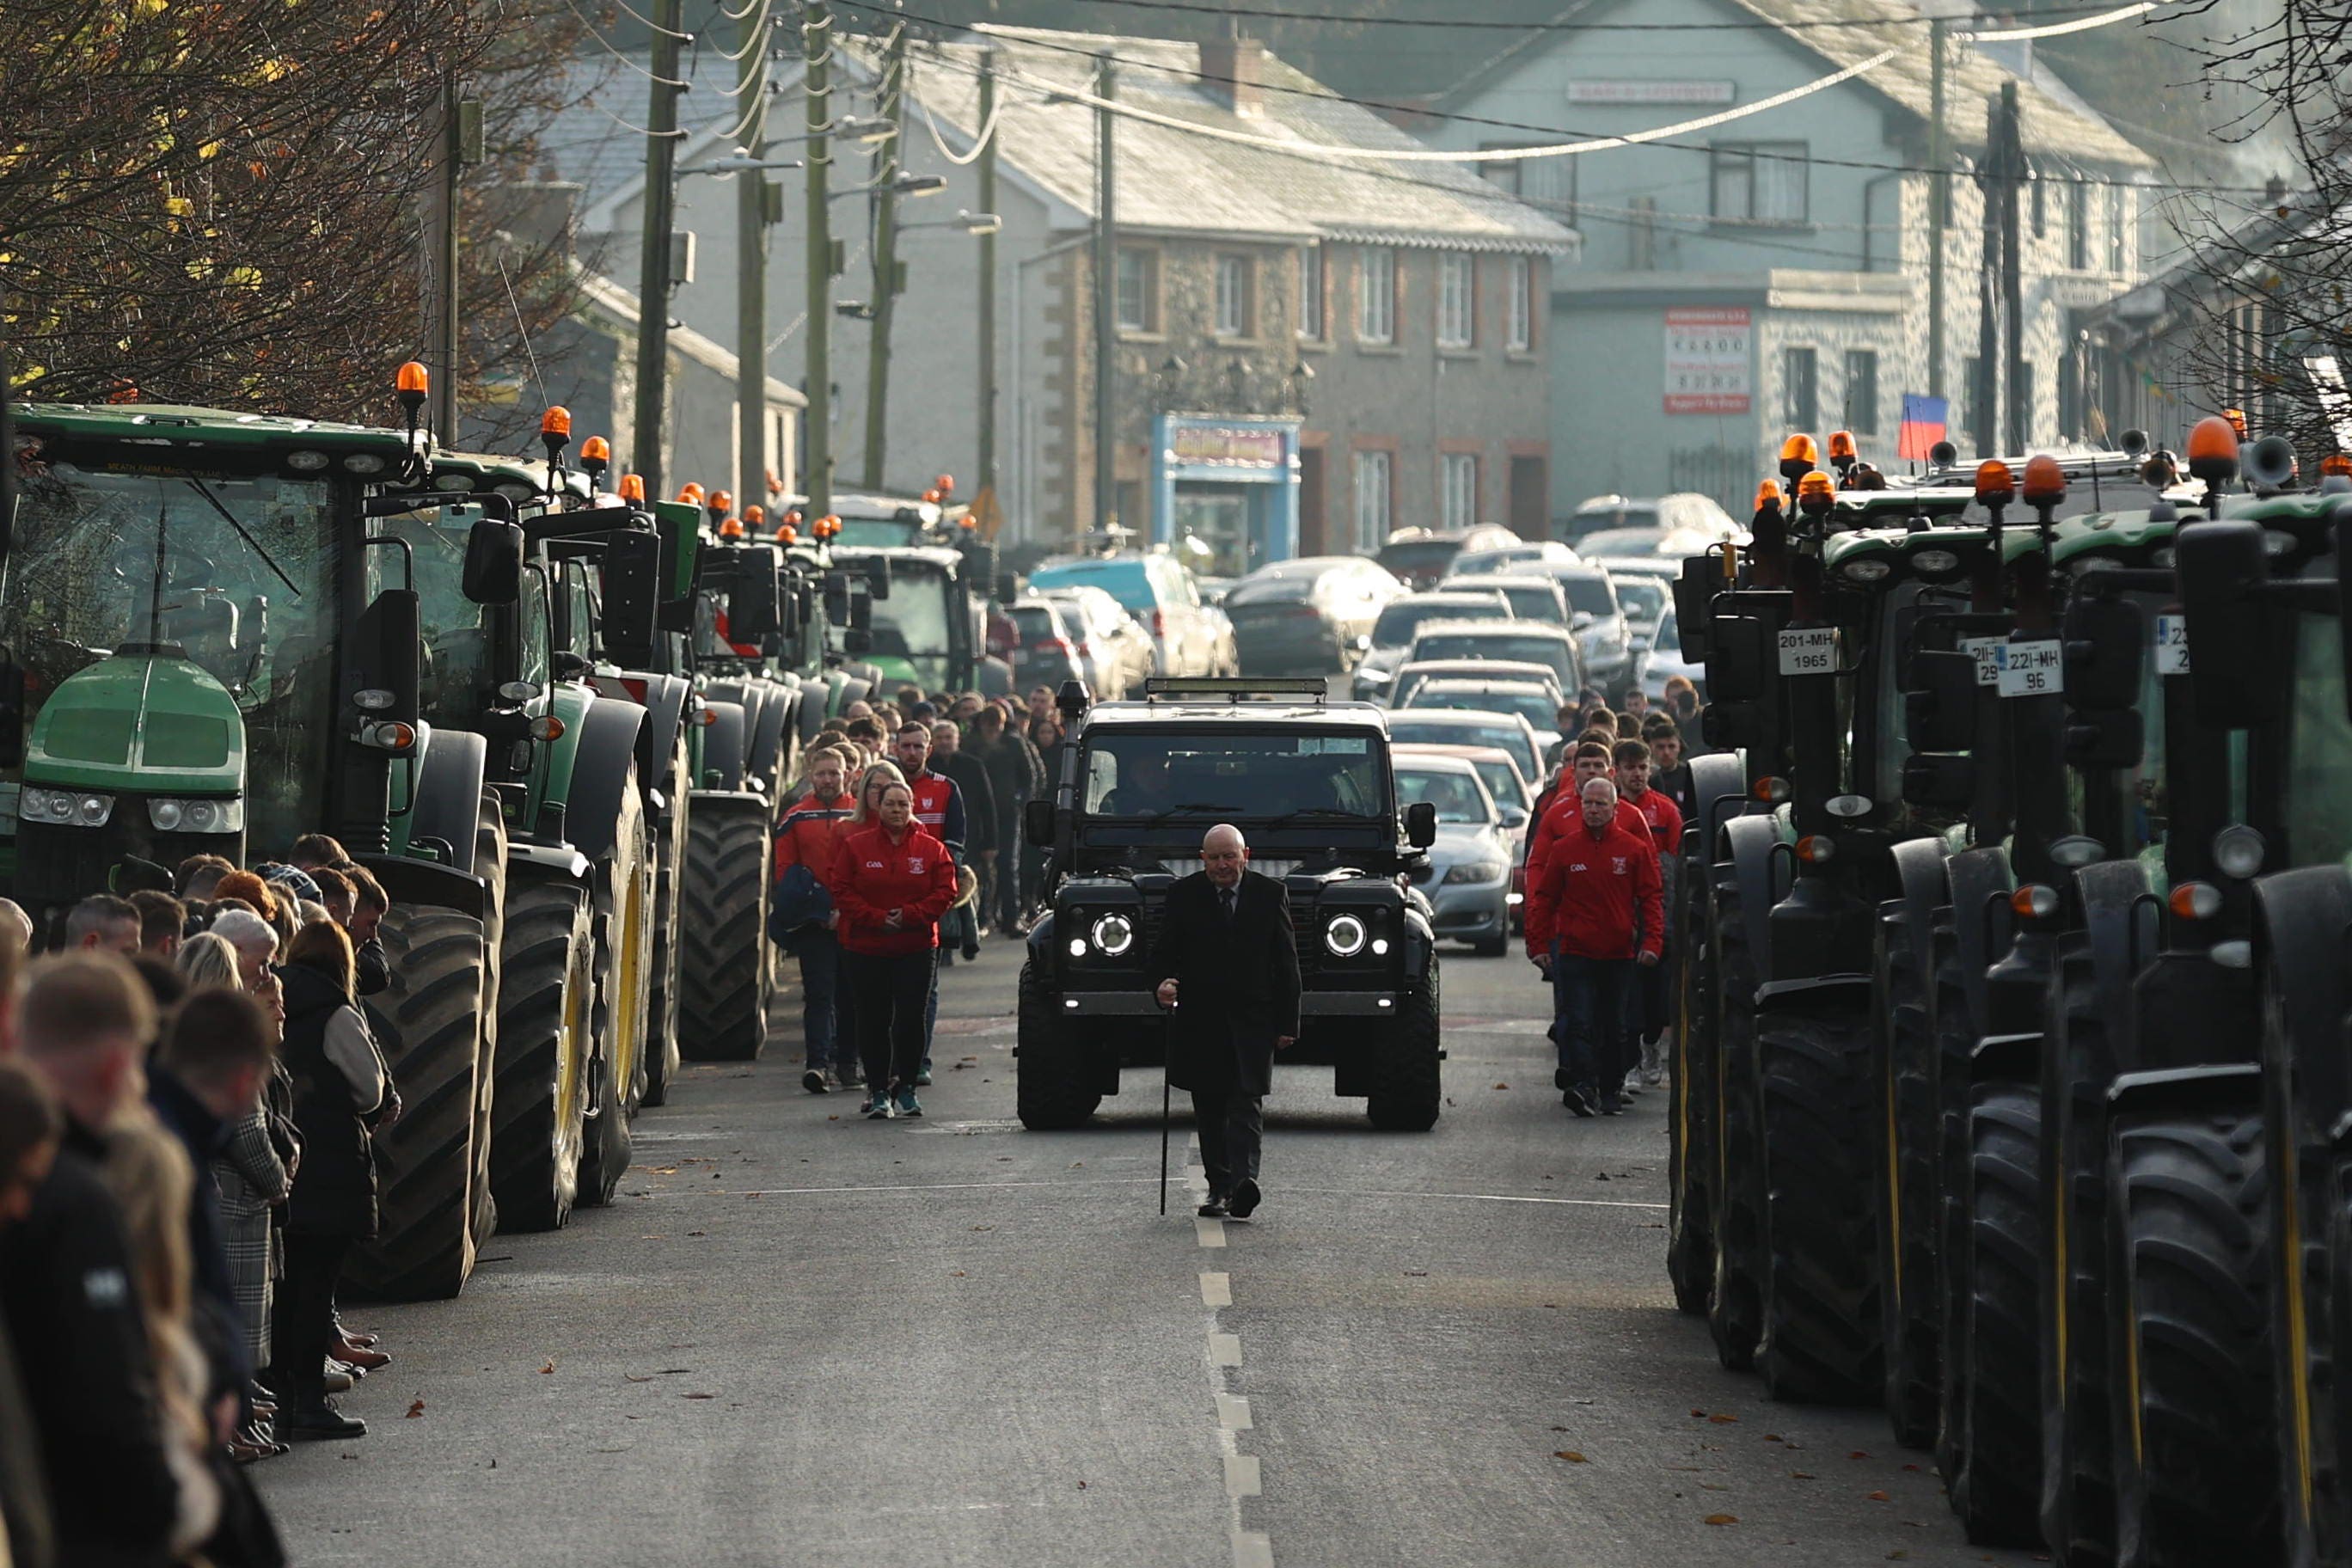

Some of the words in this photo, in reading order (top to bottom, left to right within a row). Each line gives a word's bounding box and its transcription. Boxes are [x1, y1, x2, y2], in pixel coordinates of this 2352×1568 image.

[1780, 633, 1833, 648] 201-MH
[1794, 654, 1828, 668] 1965
[2010, 650, 2058, 670] 221-MH
[2026, 672, 2046, 689] 96
